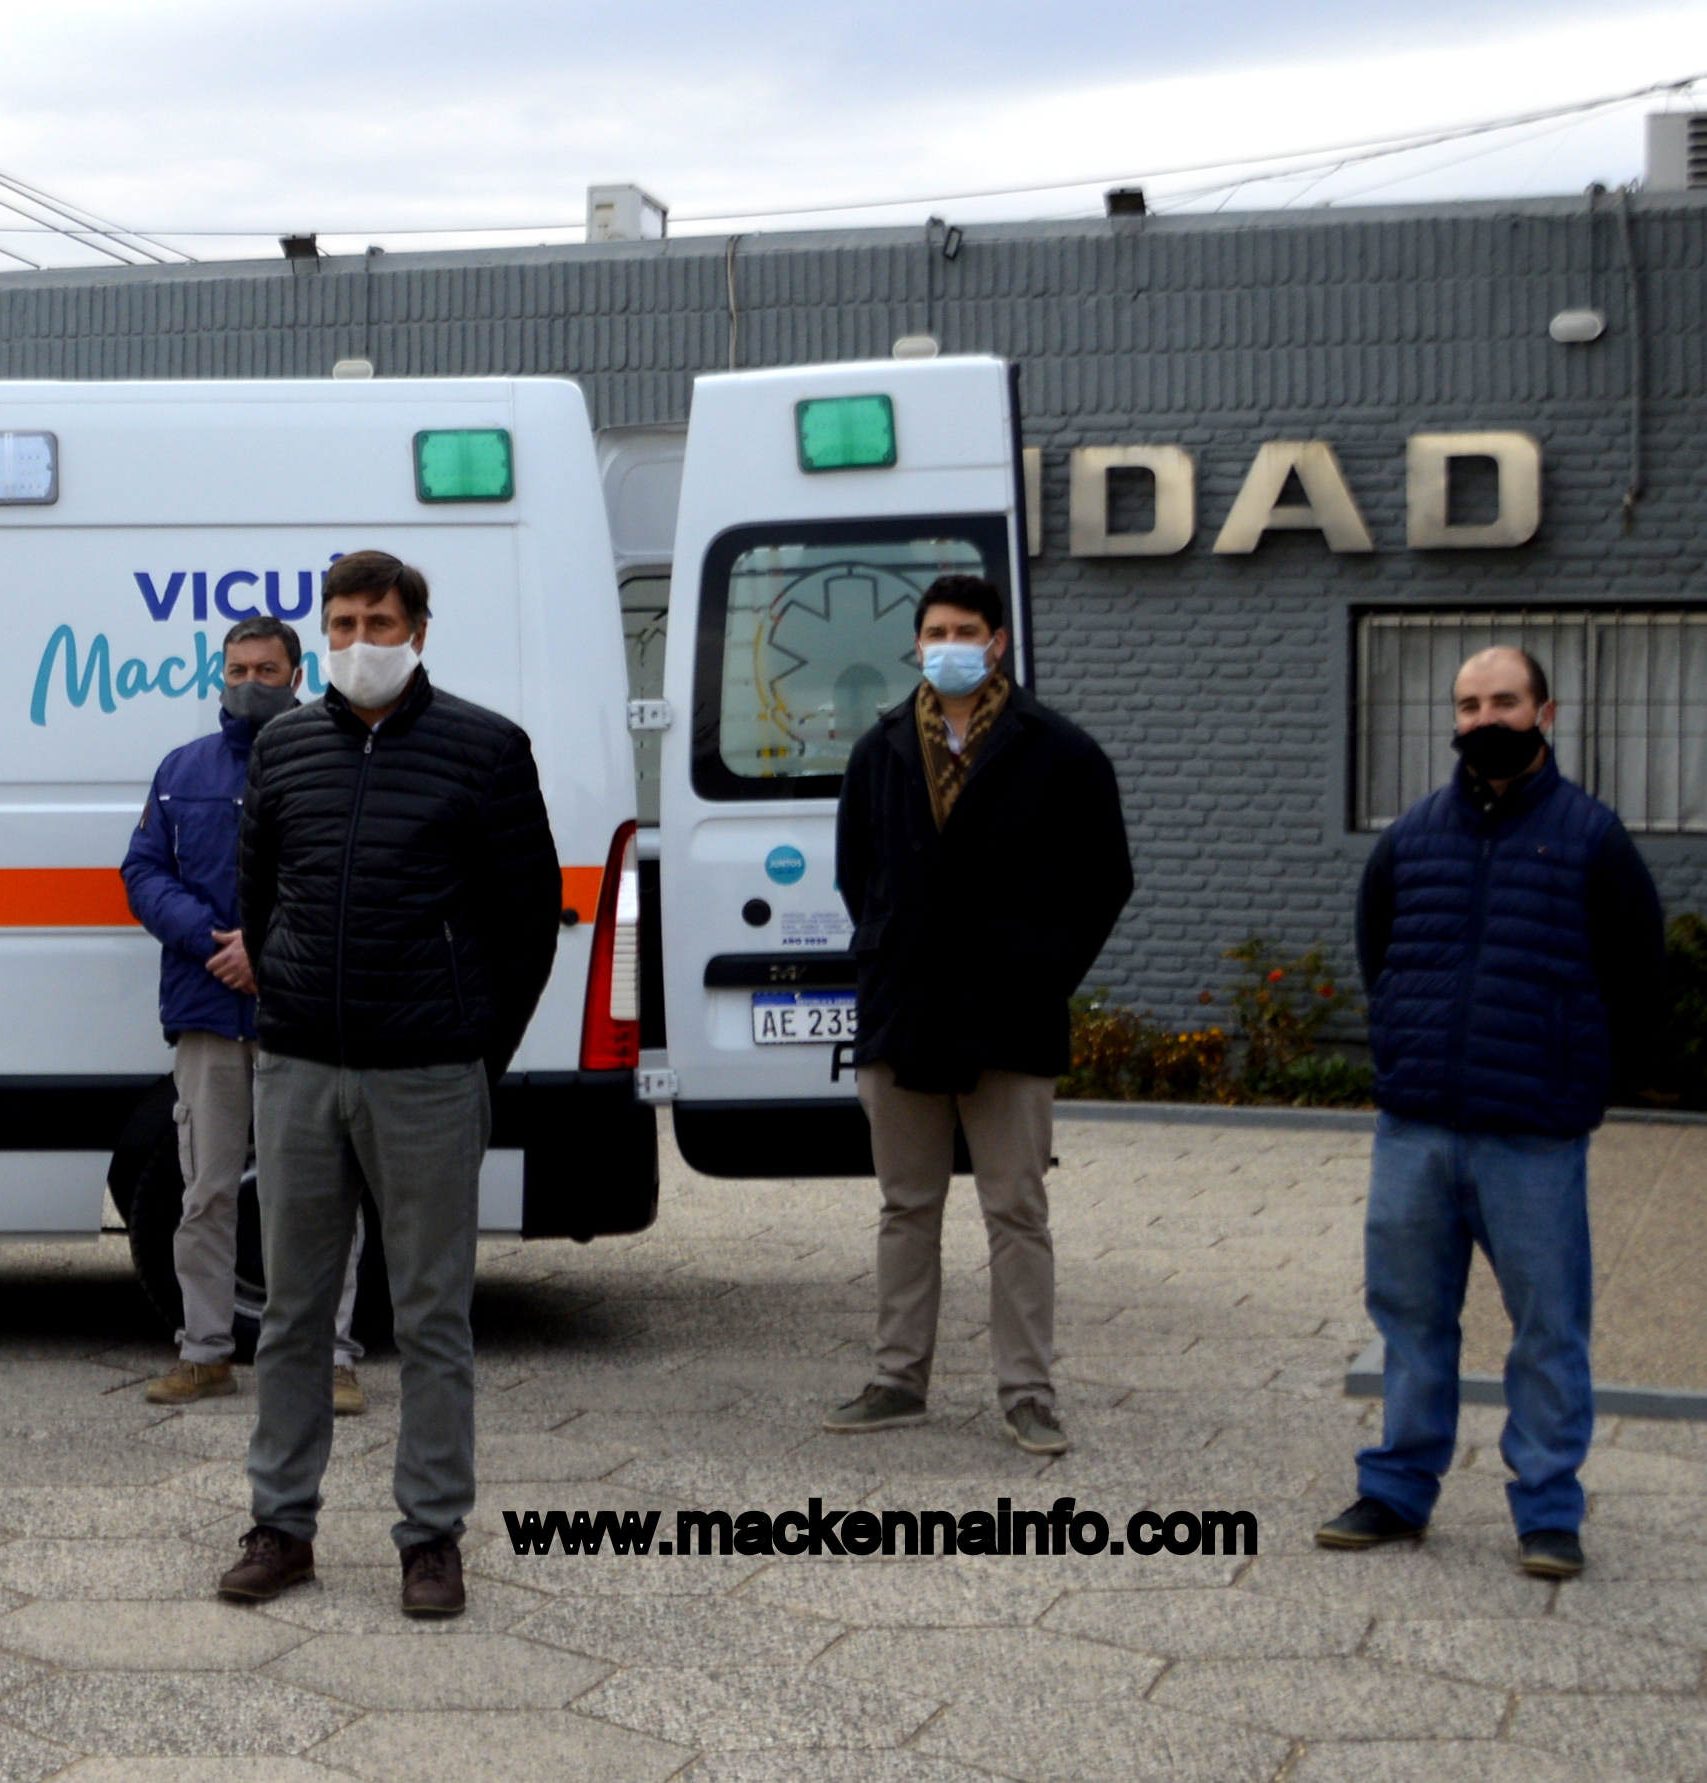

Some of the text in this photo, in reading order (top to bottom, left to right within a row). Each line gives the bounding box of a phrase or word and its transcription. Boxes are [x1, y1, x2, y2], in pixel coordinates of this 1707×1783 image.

[133, 553, 432, 622] VICU
[762, 1008, 858, 1038] AE 235
